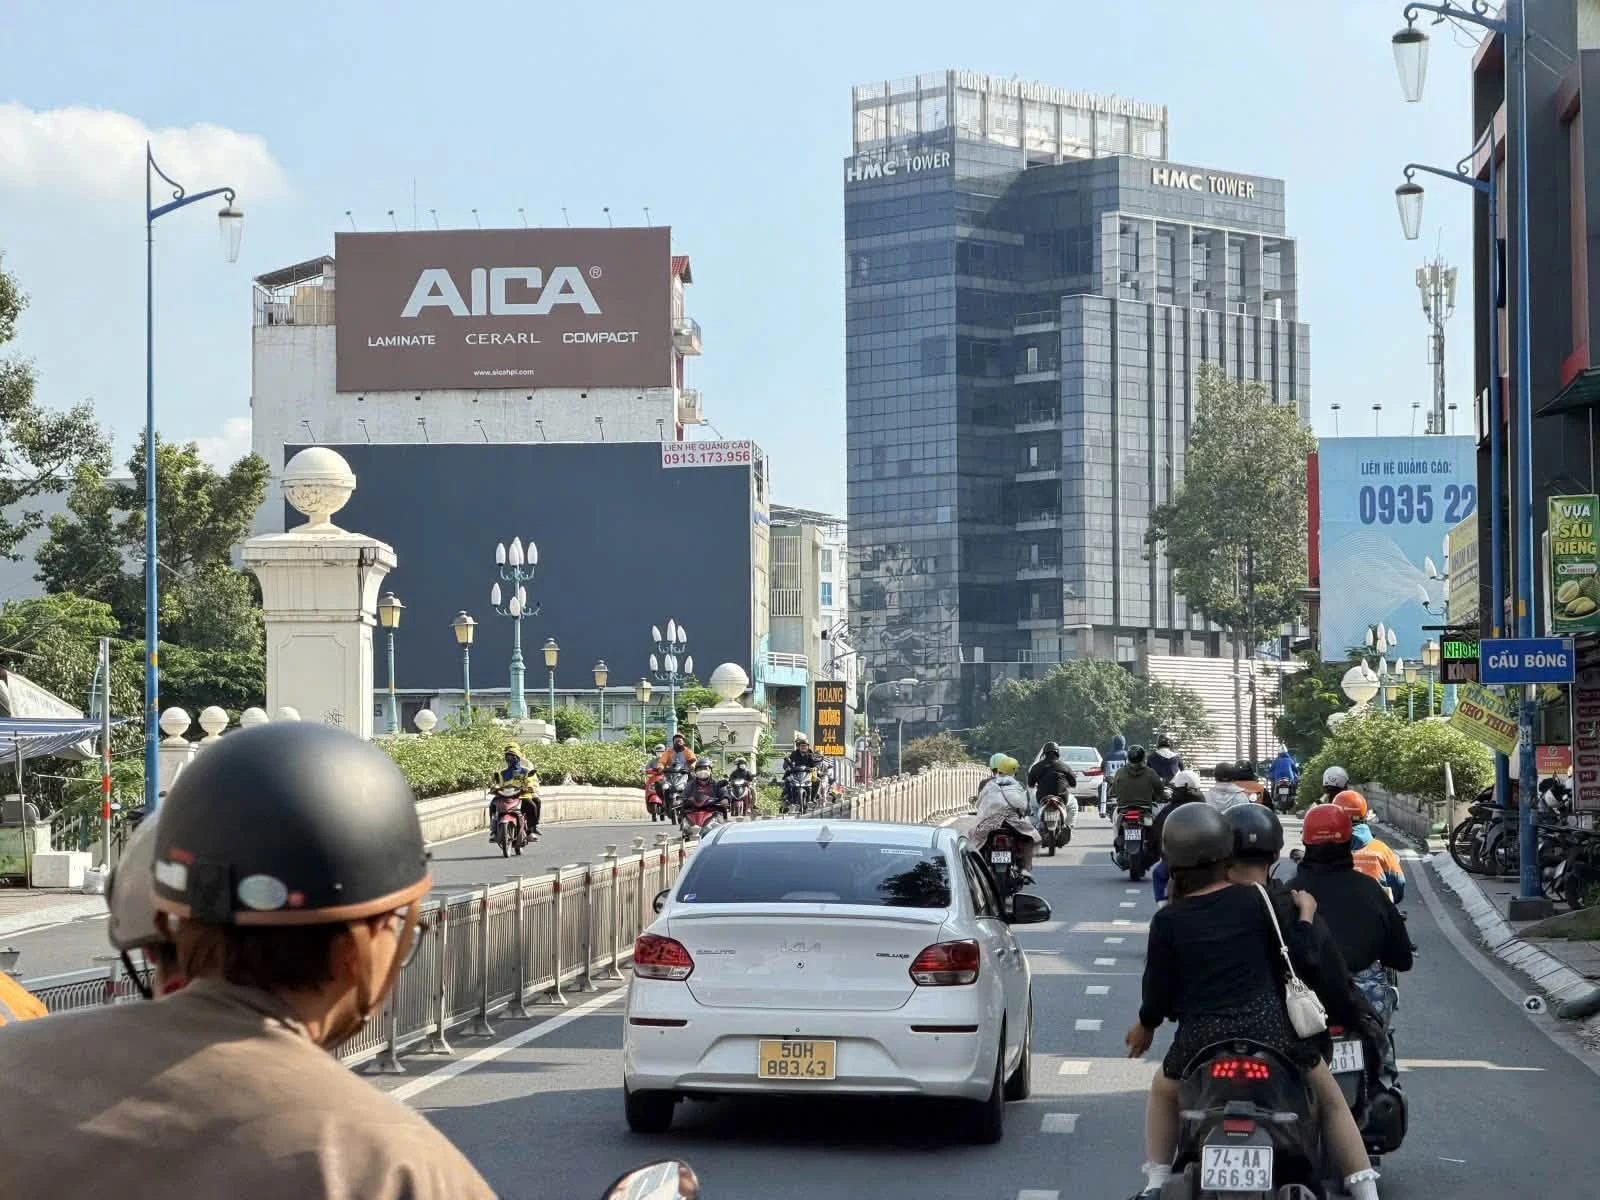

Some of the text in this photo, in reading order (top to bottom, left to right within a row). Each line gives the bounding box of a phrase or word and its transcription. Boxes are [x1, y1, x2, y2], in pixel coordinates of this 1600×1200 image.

[847, 151, 950, 183] HMC TOWER
[1151, 167, 1255, 199] HMC TOWER
[400, 266, 603, 318] AICA
[367, 331, 640, 347] LAMINATE CERARL COMPACT
[664, 450, 751, 465] 0913.173.956
[1359, 484, 1477, 525] 0935 22
[1488, 650, 1567, 669] CẦU BÔNG
[1459, 701, 1485, 721] CHO
[822, 728, 837, 743] 244
[781, 1042, 814, 1059] 50H
[767, 1059, 827, 1077] 883.43
[1212, 1148, 1261, 1169] 74-AA
